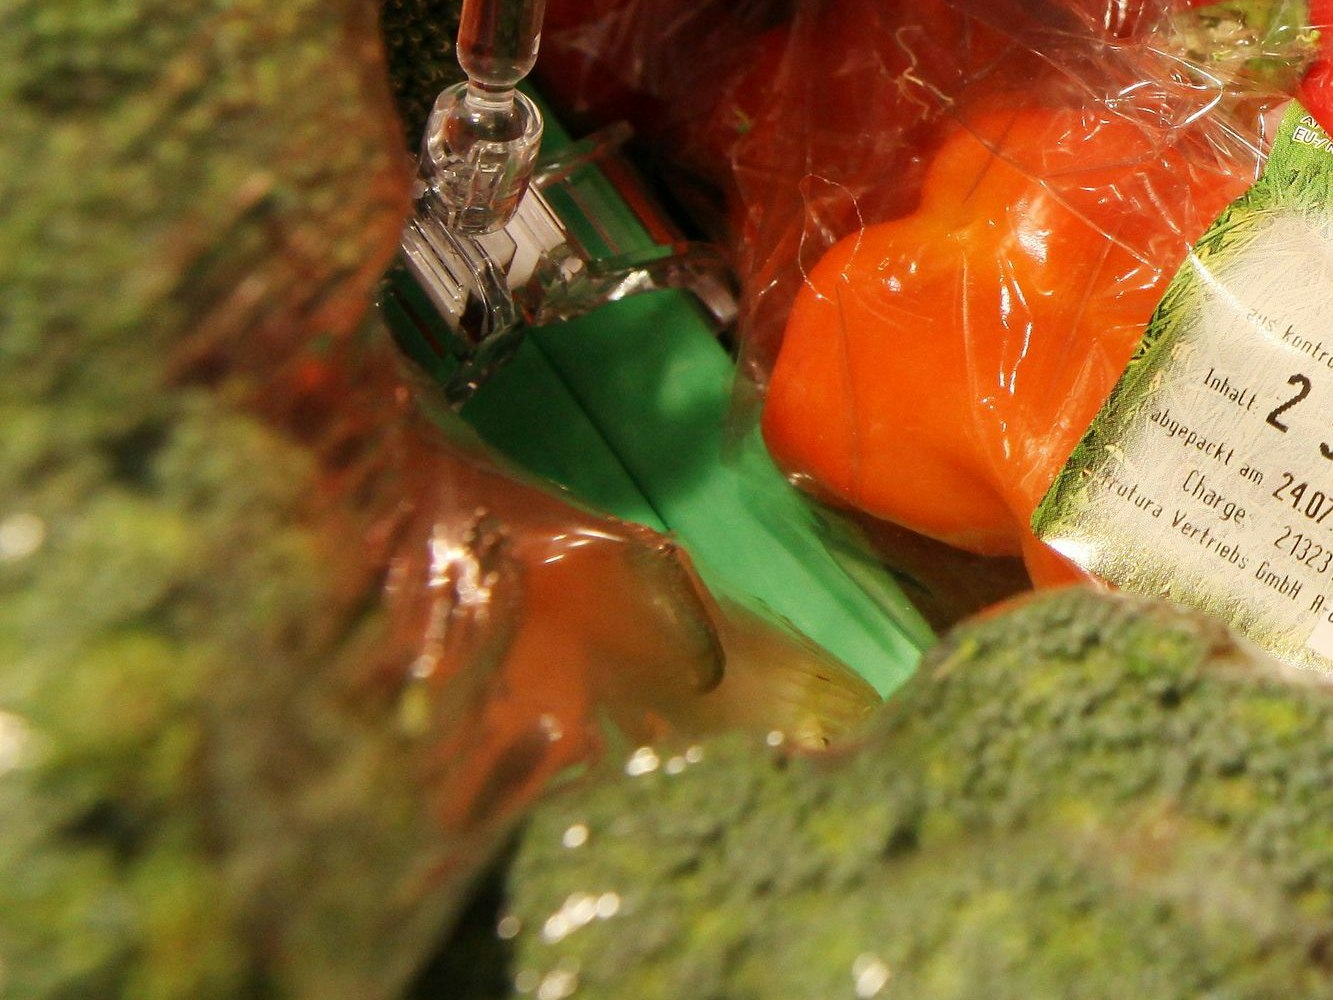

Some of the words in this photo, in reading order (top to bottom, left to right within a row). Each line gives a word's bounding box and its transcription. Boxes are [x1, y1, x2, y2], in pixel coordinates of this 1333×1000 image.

[1265, 372, 1312, 434] 2
[1150, 409, 1235, 467] abgepackt
[1171, 508, 1250, 571] Vertriebs
[1254, 560, 1304, 602] GmbH
